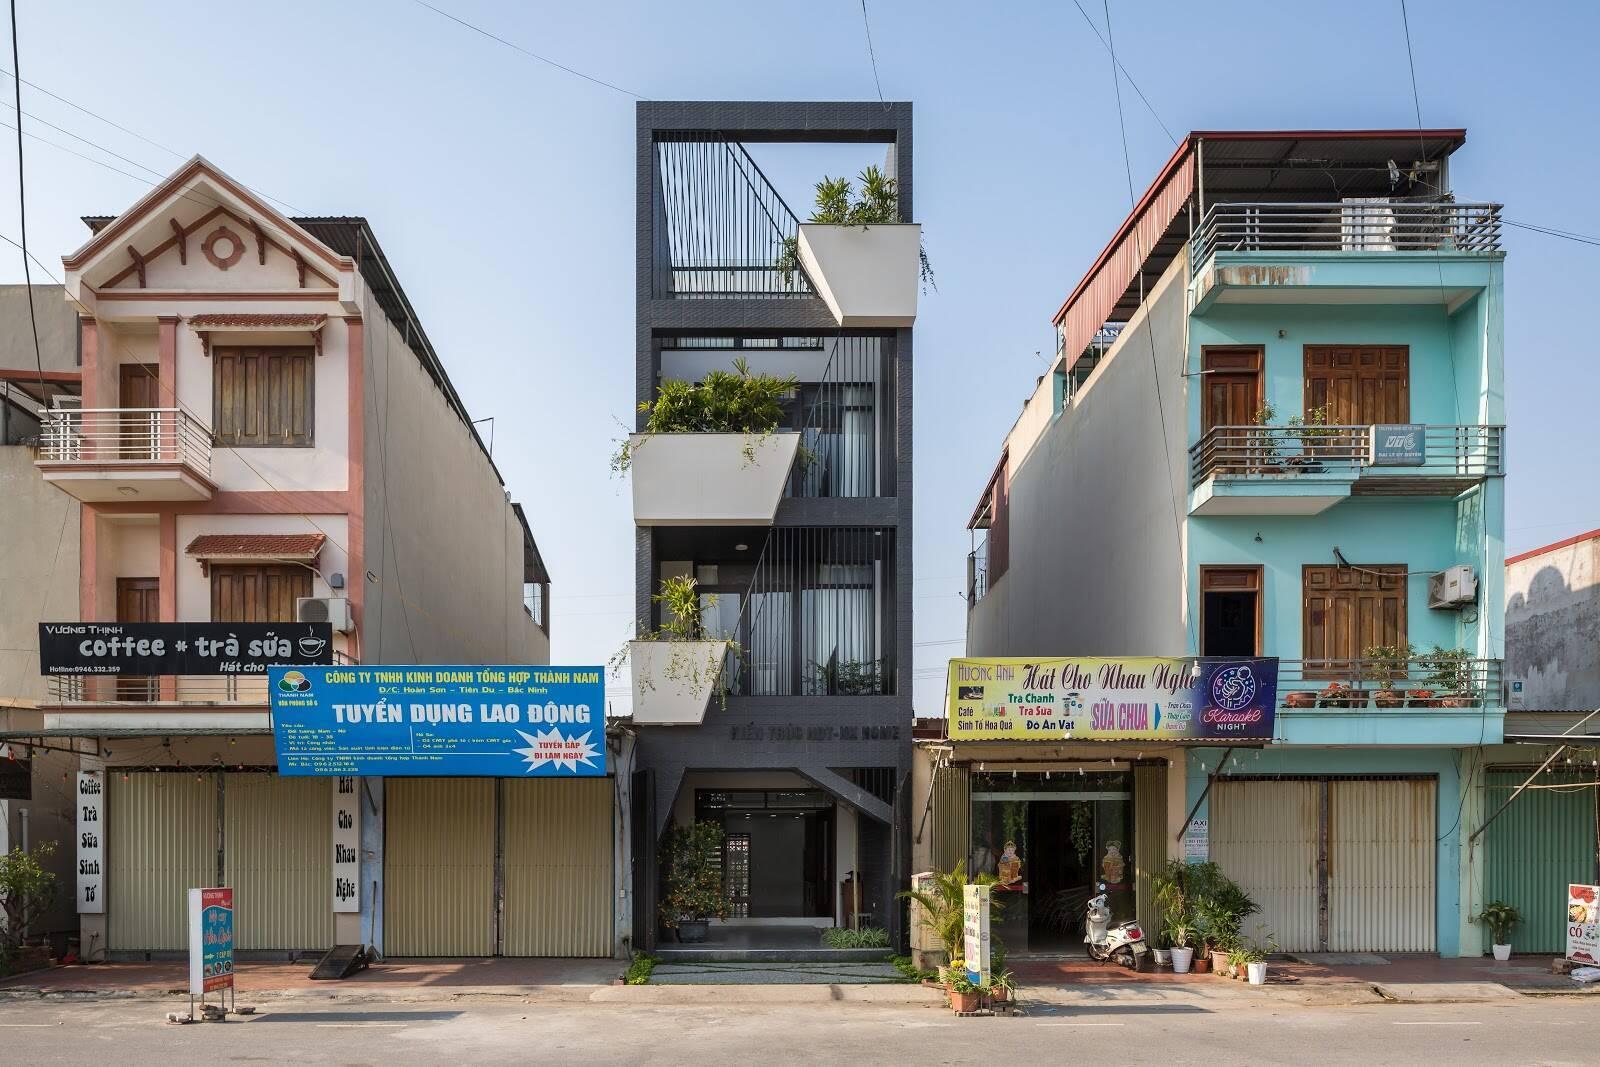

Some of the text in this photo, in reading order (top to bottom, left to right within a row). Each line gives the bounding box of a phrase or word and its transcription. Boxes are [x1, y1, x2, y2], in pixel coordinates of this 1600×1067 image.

[46, 625, 87, 634] VƯƠNG
[79, 631, 292, 658] coffee trà sữa
[219, 661, 242, 672] Hát
[243, 662, 265, 672] cho
[325, 667, 599, 685] CÔNG TY TNHH KINH DOANH TỔNG HỢP THÀNH NAM
[1022, 663, 1197, 696] Hát Cho Nhau Nghe
[1025, 692, 1055, 704] Chanh
[332, 697, 591, 726] TUYỂN DỤNG LAO ĐỘNG
[1203, 708, 1262, 723] Karaoke
[958, 720, 973, 731] Sinh
[985, 720, 998, 731] Hoa
[1216, 723, 1247, 731] NIGHT
[79, 779, 101, 795] Coffee
[82, 805, 98, 822] Trà
[338, 809, 353, 830] Cho
[81, 832, 98, 849] Sữa
[335, 844, 356, 864] Nhau
[79, 859, 100, 875] Sinh
[85, 884, 97, 902] Tố
[335, 877, 355, 902] Nghe
